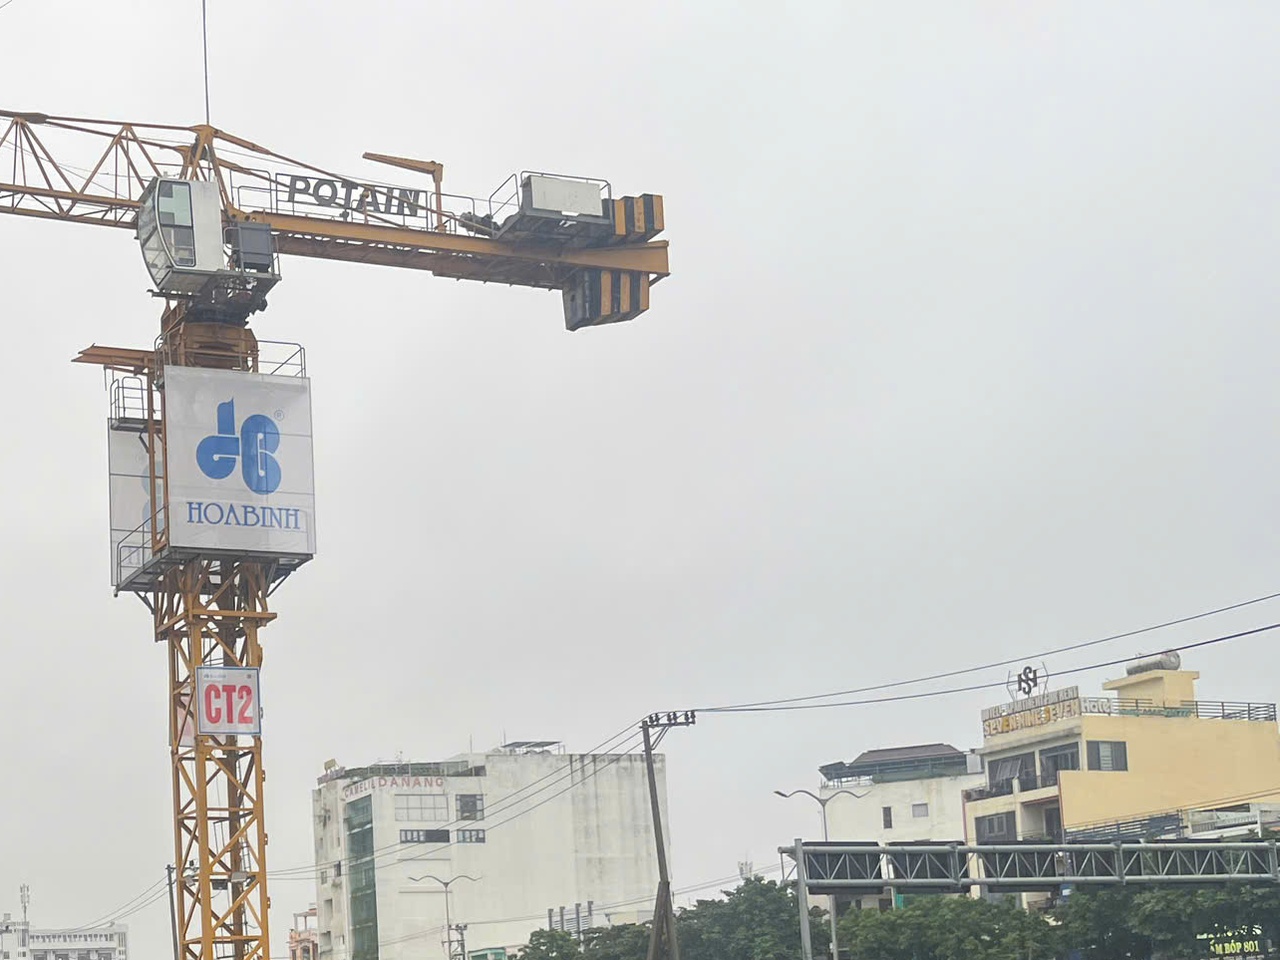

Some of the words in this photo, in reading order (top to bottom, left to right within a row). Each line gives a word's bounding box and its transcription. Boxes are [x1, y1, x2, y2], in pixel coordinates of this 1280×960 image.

[287, 174, 420, 216] POTAIN
[187, 501, 300, 529] HOABINH
[204, 684, 254, 724] CT2
[1243, 940, 1260, 953] 801
